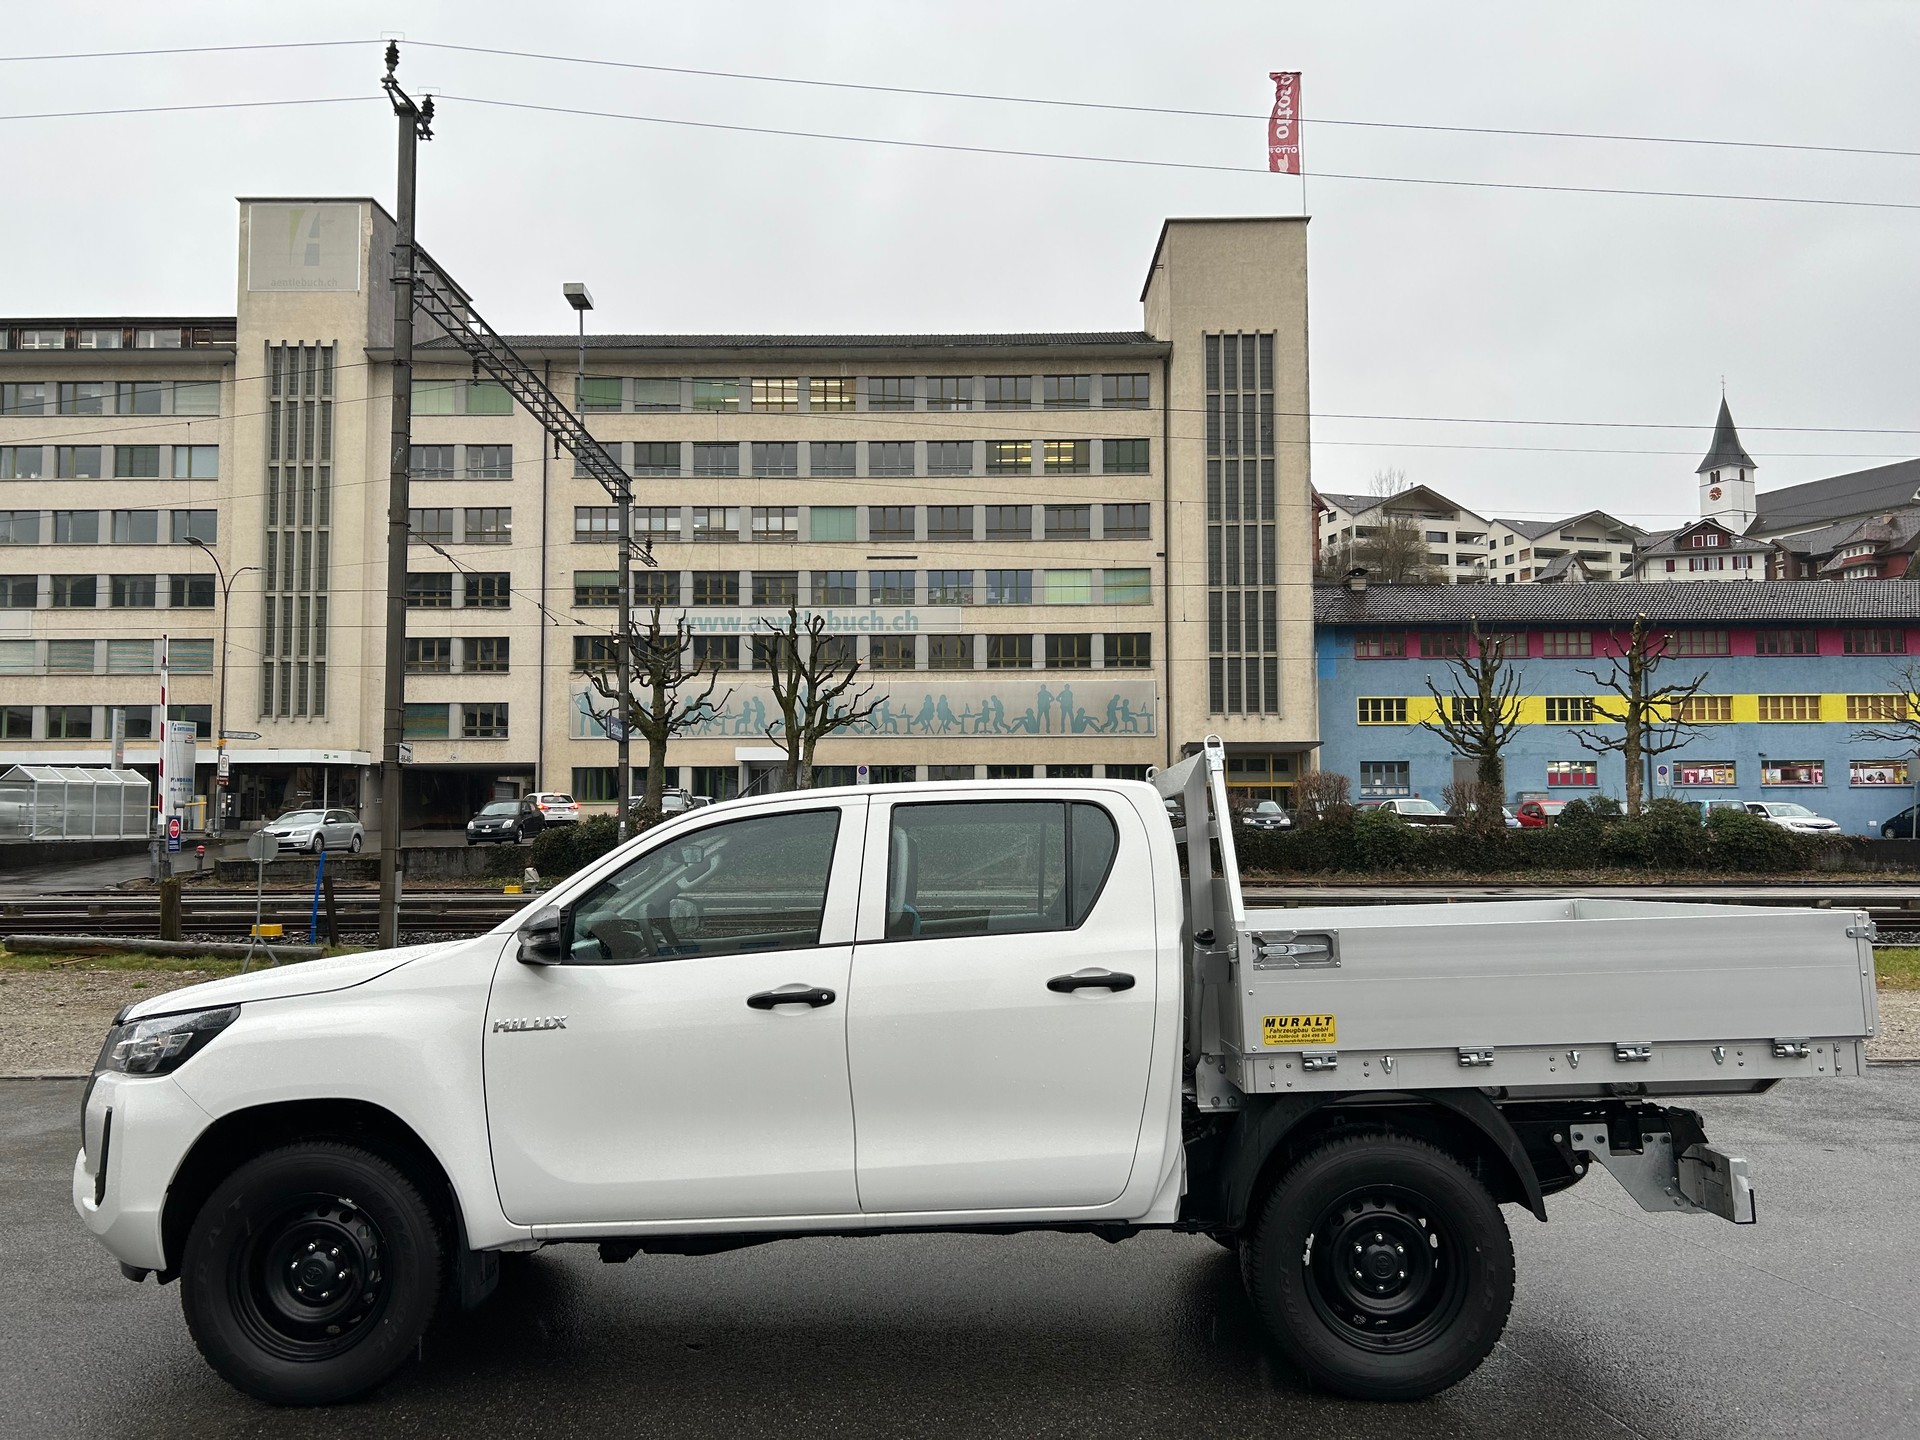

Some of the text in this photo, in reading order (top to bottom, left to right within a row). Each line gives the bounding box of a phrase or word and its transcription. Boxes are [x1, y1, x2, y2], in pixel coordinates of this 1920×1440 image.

[270, 278, 338, 287] aentlebuch.ch
[674, 610, 919, 632] www.aentlbuch.ch
[493, 1016, 568, 1033] HILUX
[1265, 1017, 1332, 1027] MURALT
